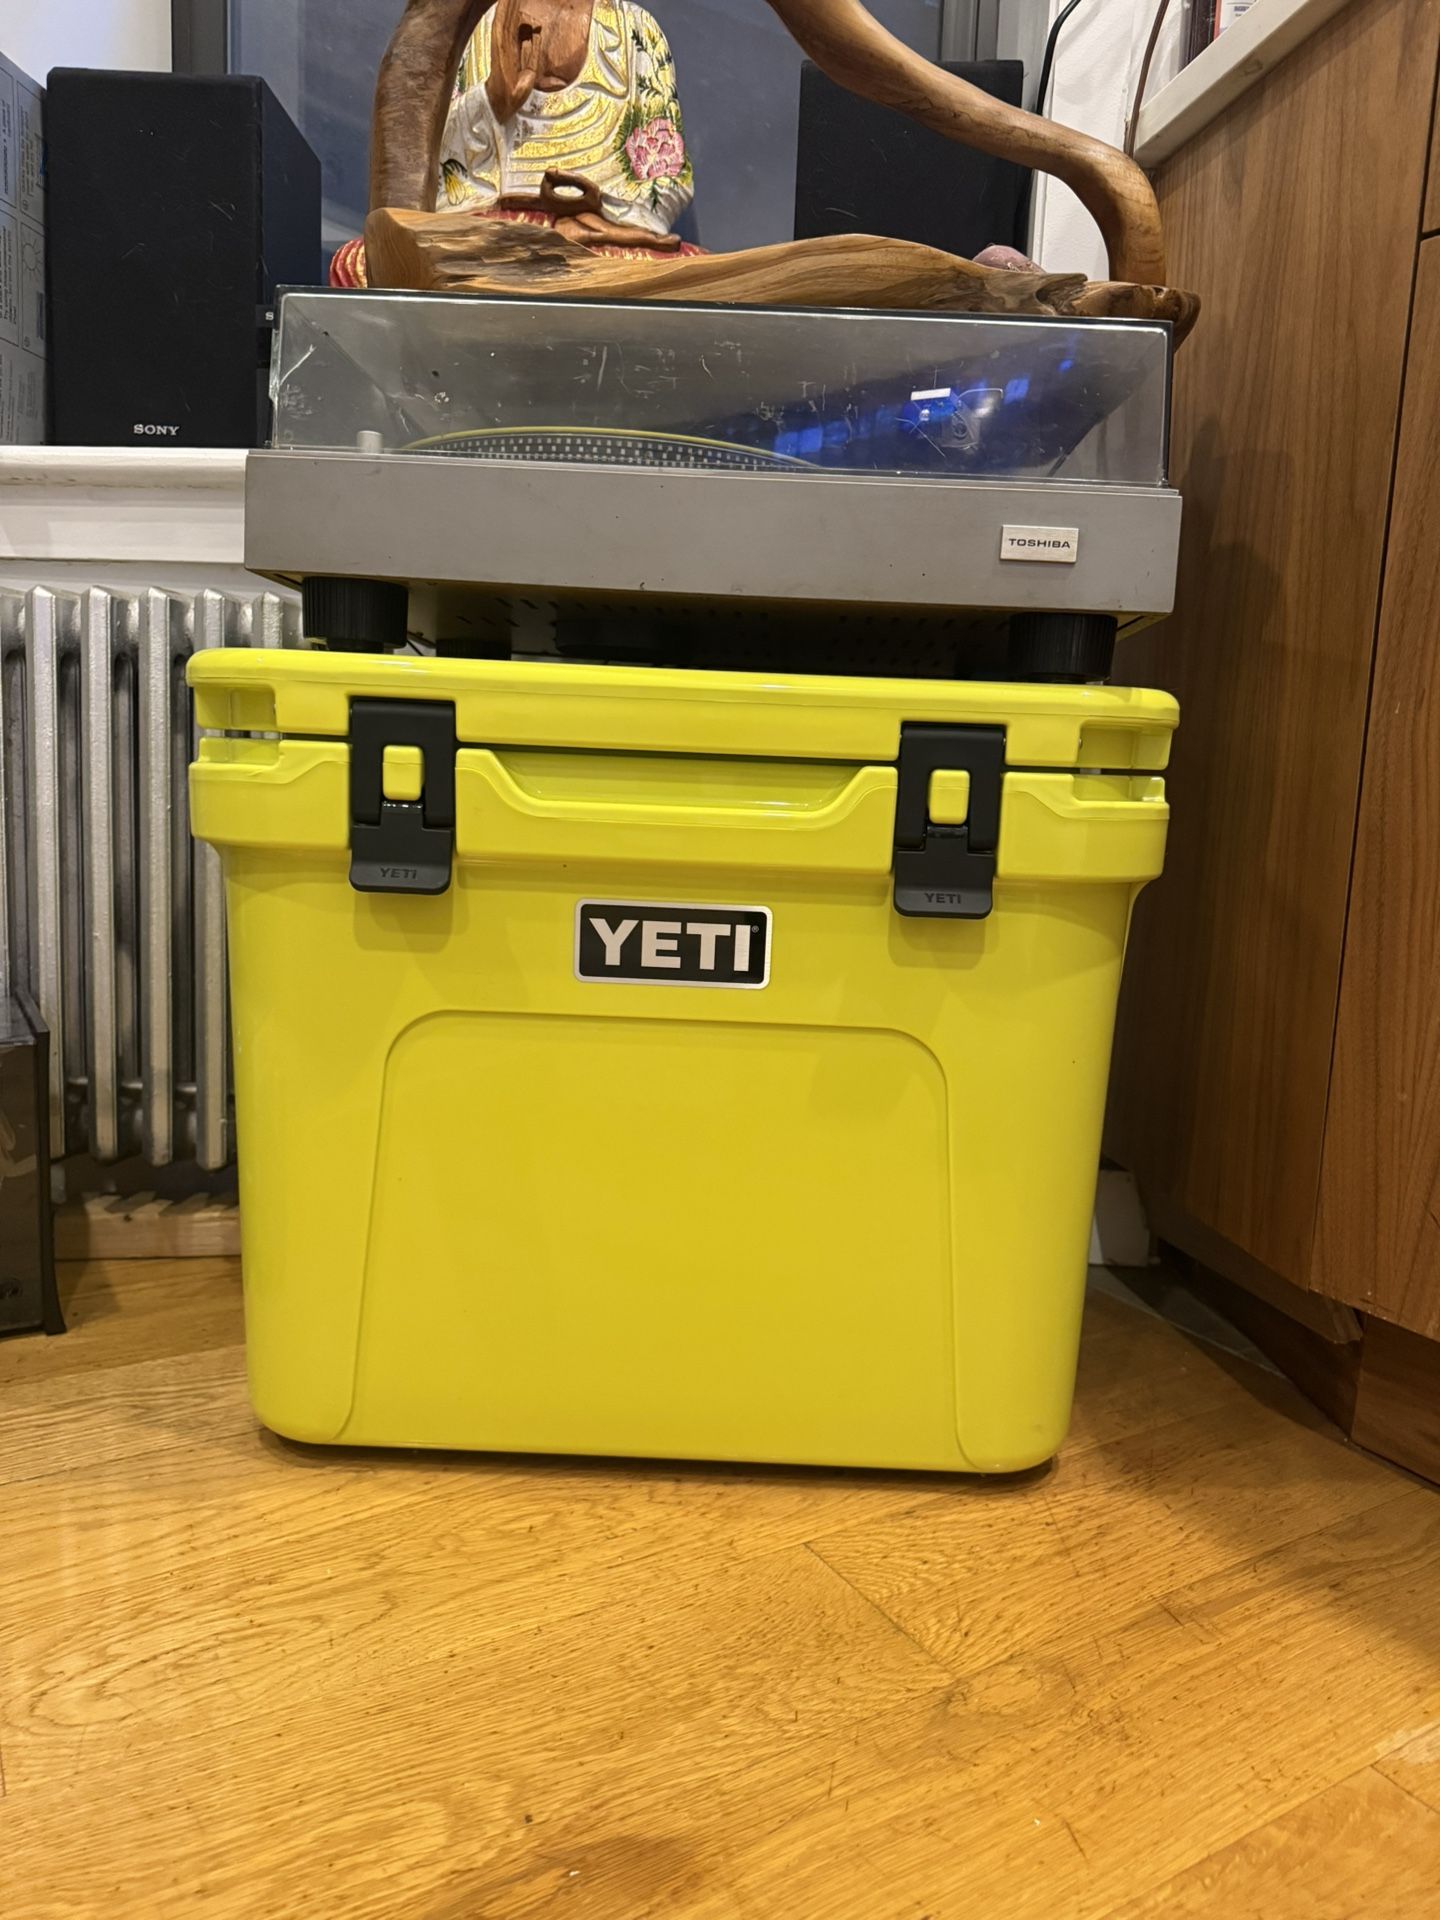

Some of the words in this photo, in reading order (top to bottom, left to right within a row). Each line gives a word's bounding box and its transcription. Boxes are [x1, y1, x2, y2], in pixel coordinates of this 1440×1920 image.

[133, 423, 180, 436] SONY
[1008, 538, 1071, 549] TOSHIBA
[380, 867, 417, 879] YETI
[924, 892, 962, 904] YETI
